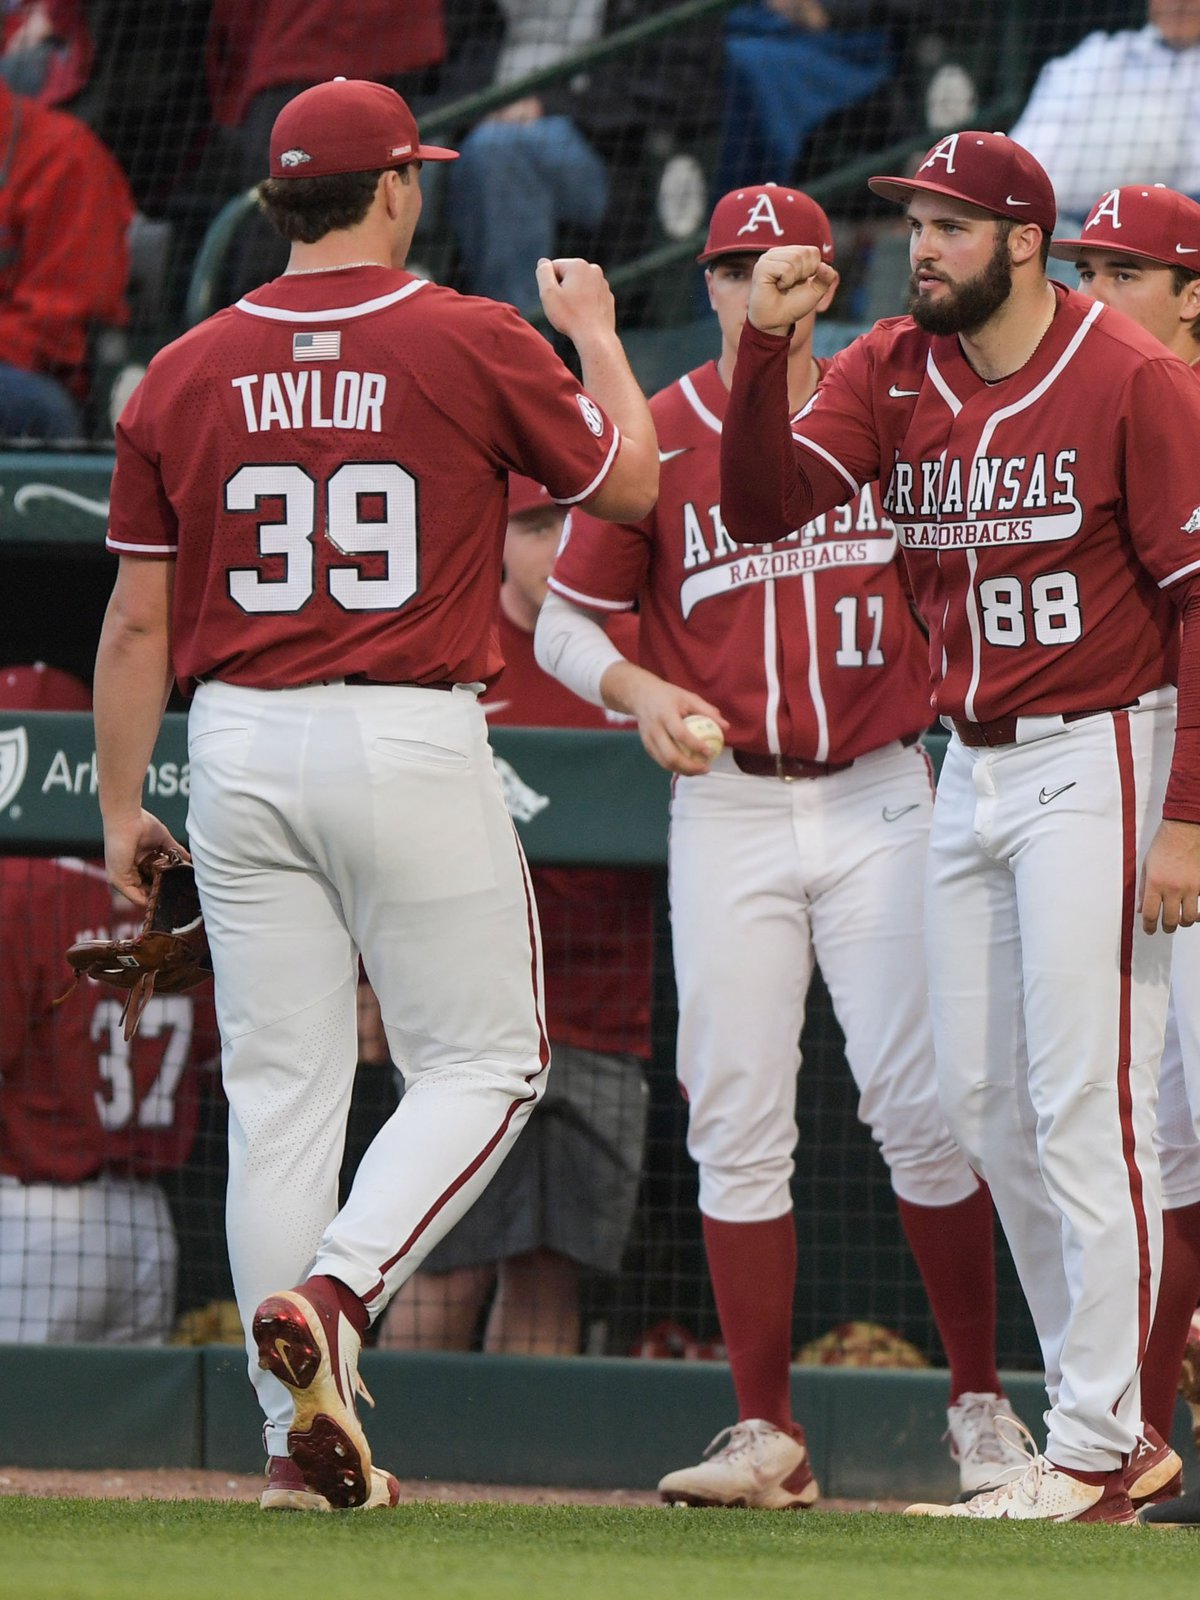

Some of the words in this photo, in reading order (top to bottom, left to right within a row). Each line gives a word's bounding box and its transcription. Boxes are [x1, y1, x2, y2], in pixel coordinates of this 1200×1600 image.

[919, 133, 956, 174] A
[737, 194, 784, 237] A
[1085, 189, 1122, 230] A
[231, 370, 387, 433] TAYLOR
[224, 461, 418, 615] 39
[903, 519, 1033, 547] RAZORBACKS
[728, 542, 868, 585] RAZORBACKS
[834, 596, 885, 667] 17
[979, 571, 1083, 647] 88
[90, 995, 194, 1131] 37
